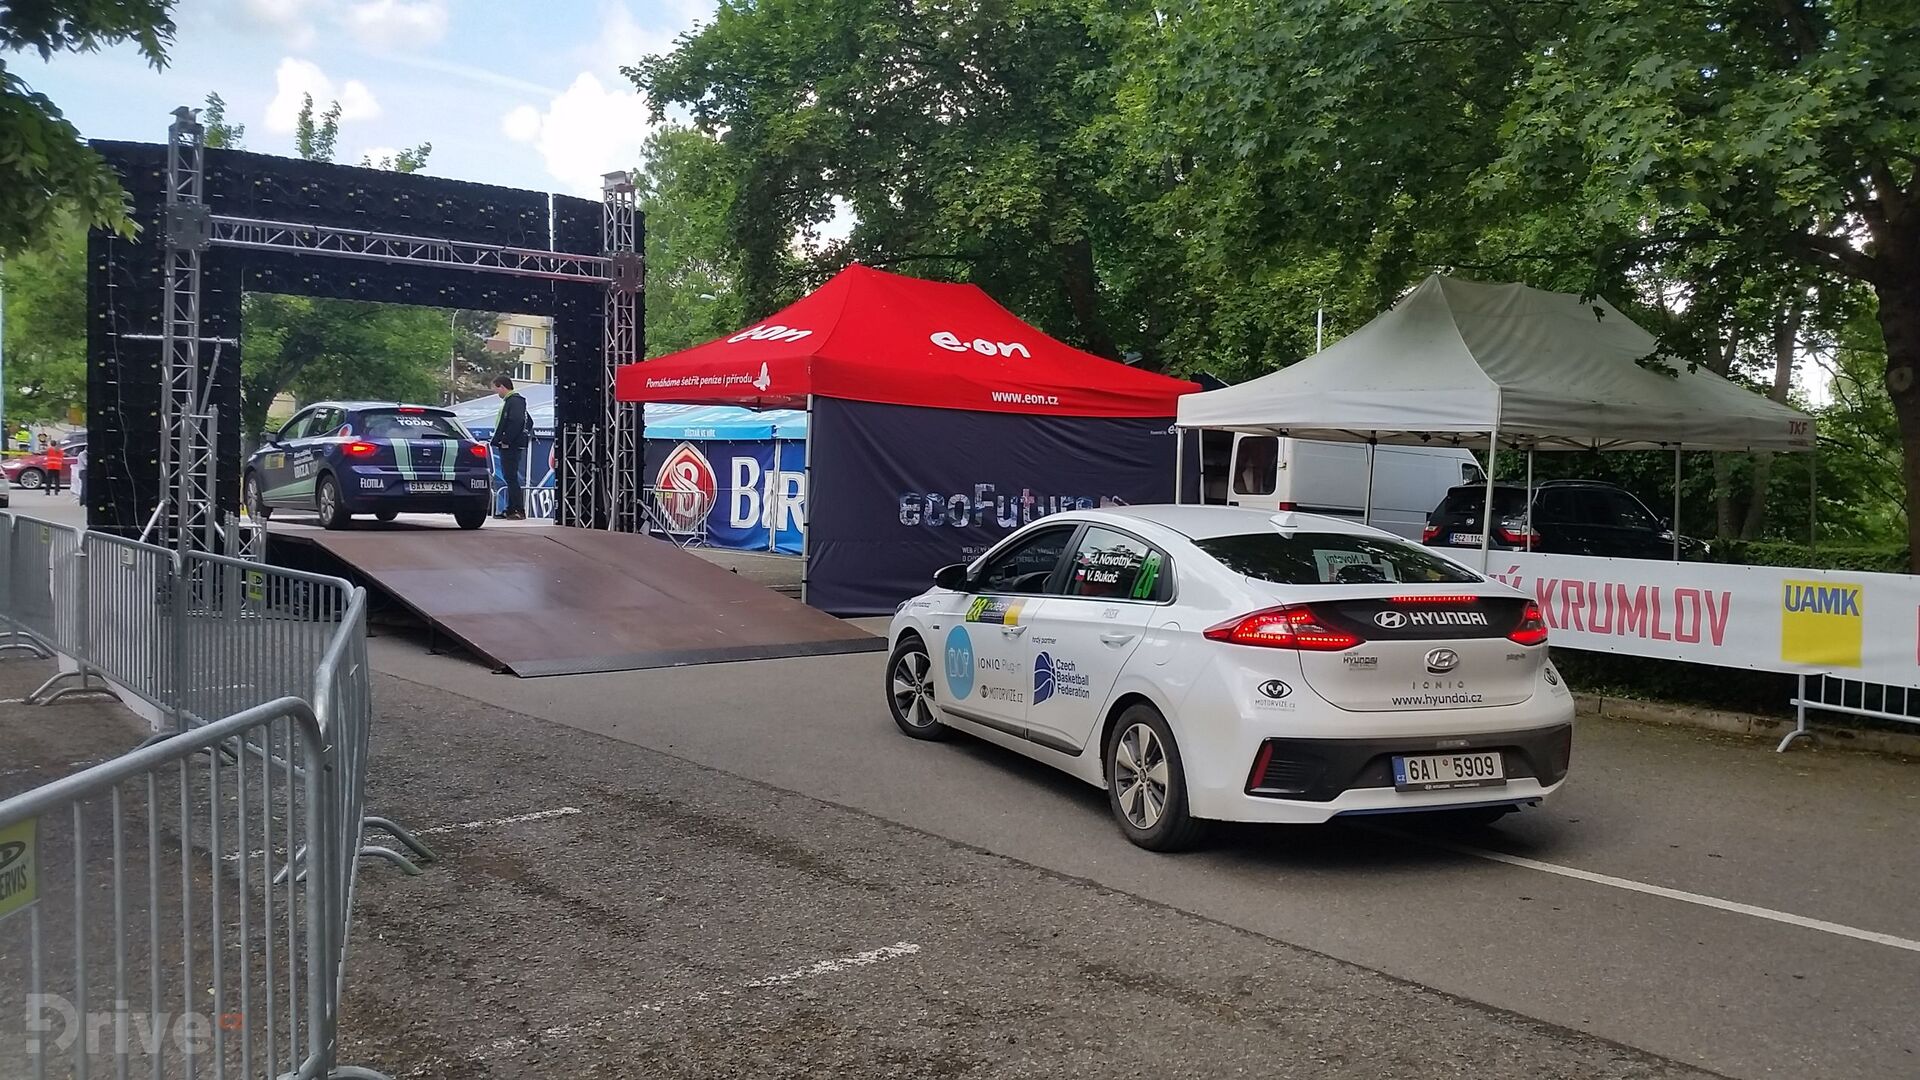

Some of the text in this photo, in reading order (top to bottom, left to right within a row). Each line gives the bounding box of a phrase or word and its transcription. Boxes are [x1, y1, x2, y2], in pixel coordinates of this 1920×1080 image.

[700, 375, 722, 388] peníze
[992, 391, 1059, 406] www.eon.cz
[360, 478, 384, 489] FLOTILA
[470, 479, 487, 489] FLOTILA
[1099, 554, 1132, 568] Novotný
[1094, 571, 1119, 583] Bukač
[1785, 584, 1860, 617] UAMK
[1410, 612, 1488, 626] HYUNDAI
[1536, 577, 1732, 647] KRUMLOV
[978, 658, 1000, 670] IONIQ
[1056, 659, 1076, 671] Czech
[1343, 656, 1378, 664] HYUNDAI
[1056, 671, 1090, 686] Basketball
[1057, 683, 1090, 699] Federation
[1391, 692, 1483, 706] www.hyundai.cz
[1453, 756, 1494, 778] 5909
